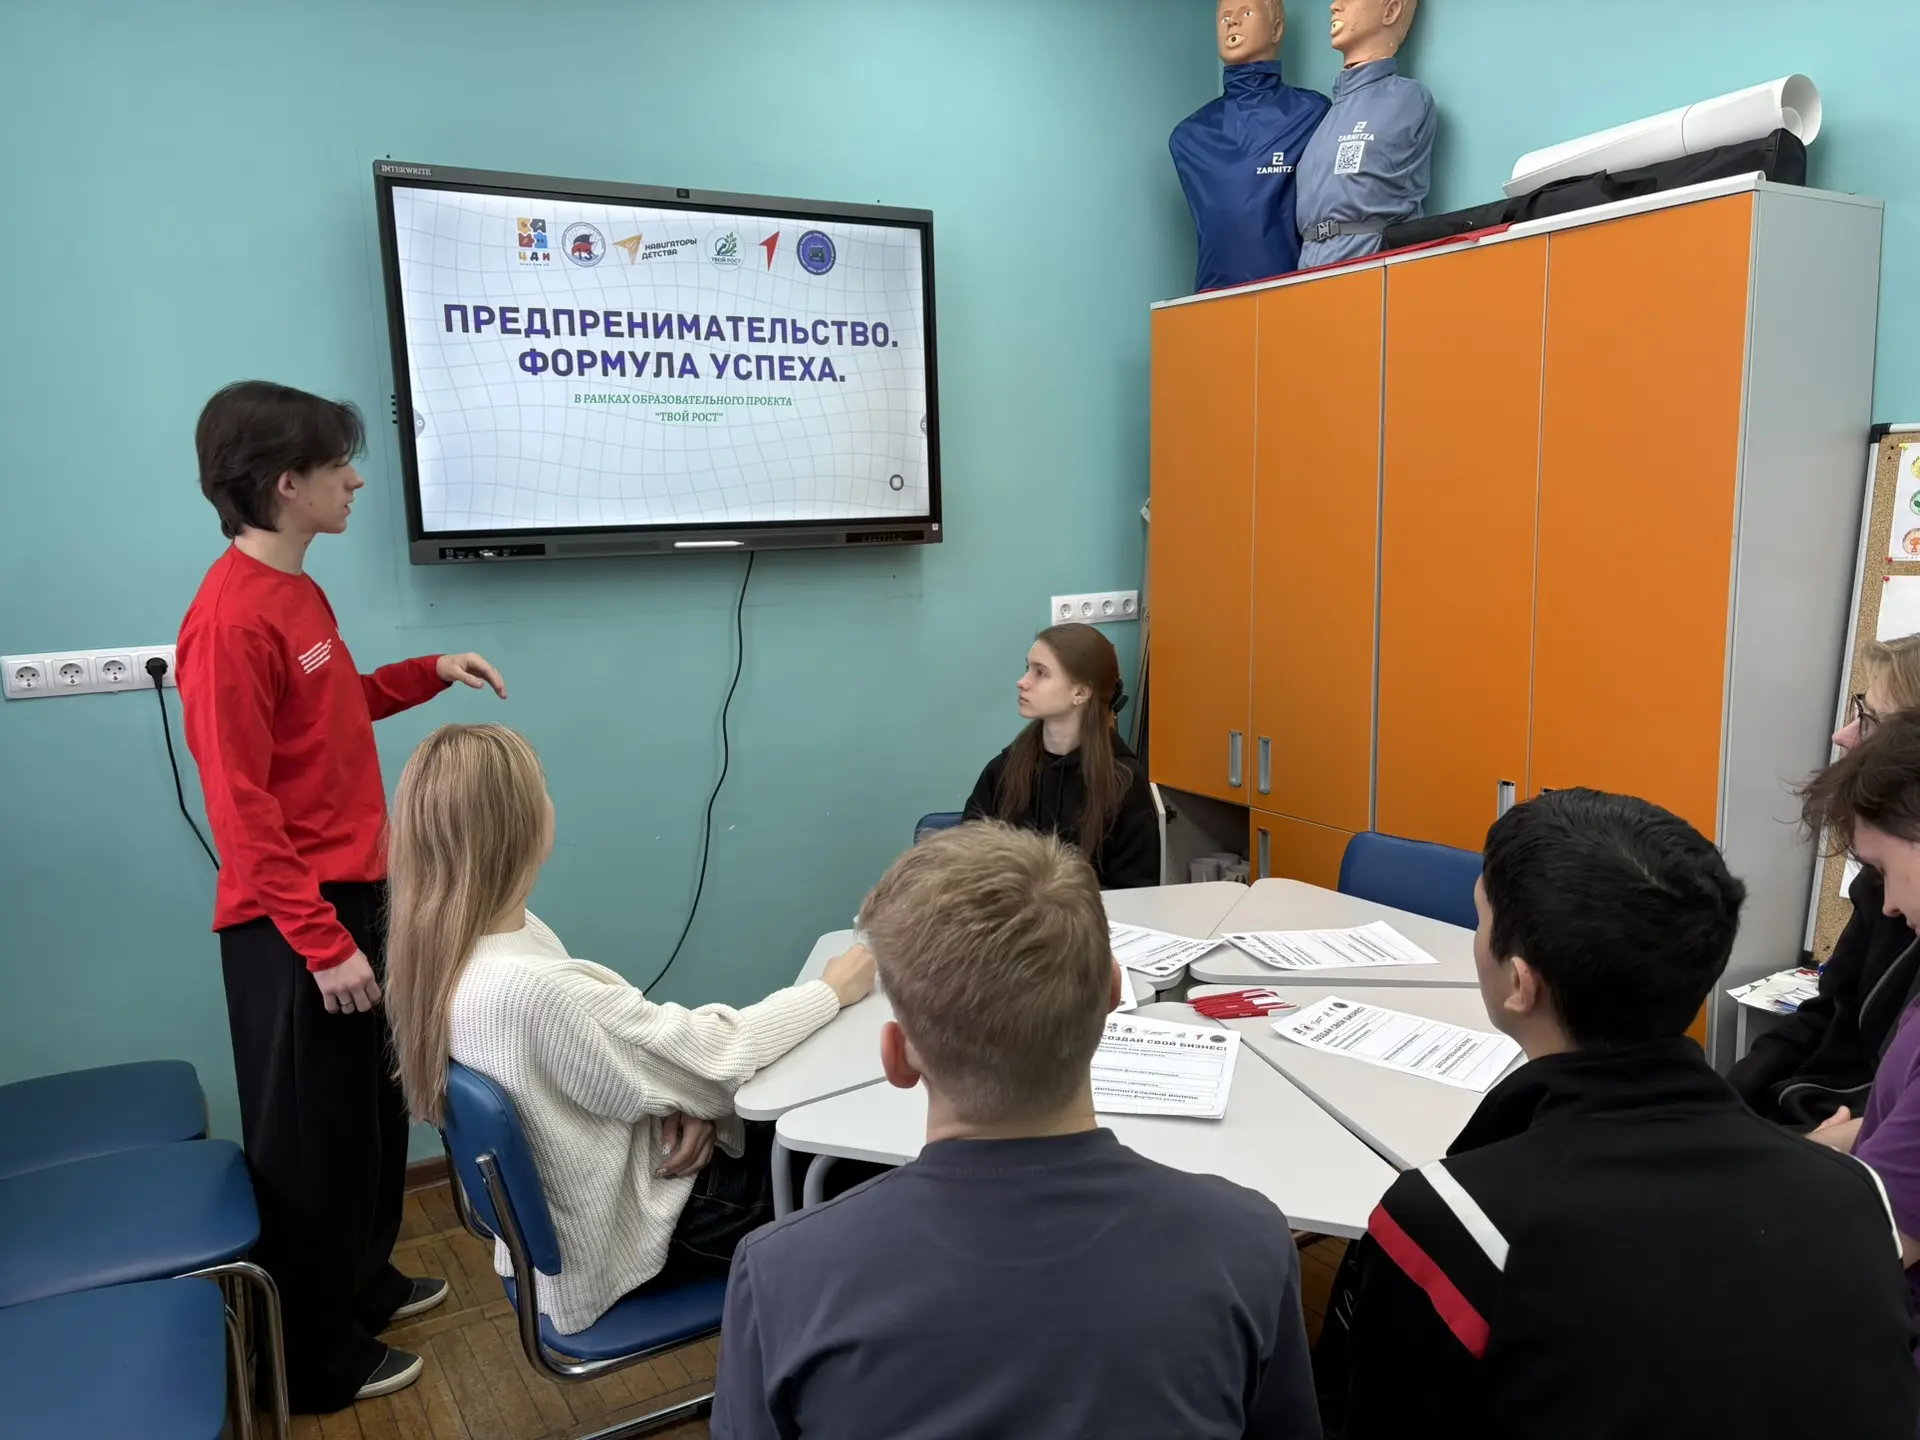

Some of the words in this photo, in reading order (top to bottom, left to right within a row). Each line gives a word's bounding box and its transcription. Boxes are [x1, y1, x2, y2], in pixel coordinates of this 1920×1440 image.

[1337, 133, 1375, 142] ZARNITZA
[381, 164, 432, 176] INTERWRITE
[645, 238, 697, 251] НАВИГАТОРЫ
[641, 248, 678, 261] ДЕТСТВА
[444, 303, 899, 348] ПРЕДПРЕНИМАТЕЛЬСТВО.
[518, 348, 700, 379] ФОРМУЛА
[709, 353, 846, 382] УСПЕХА.
[574, 394, 582, 403] В
[583, 394, 631, 404] РАМКАХ
[632, 395, 745, 406] ОБРАЗОВАТЕЛЬНОГО
[746, 396, 793, 406] ПРОЕКТА
[1101, 1034, 1144, 1043] СОЗДАЙ
[1147, 1039, 1176, 1047] СВОЙ
[1180, 1042, 1227, 1052] БИЗНЕС!
